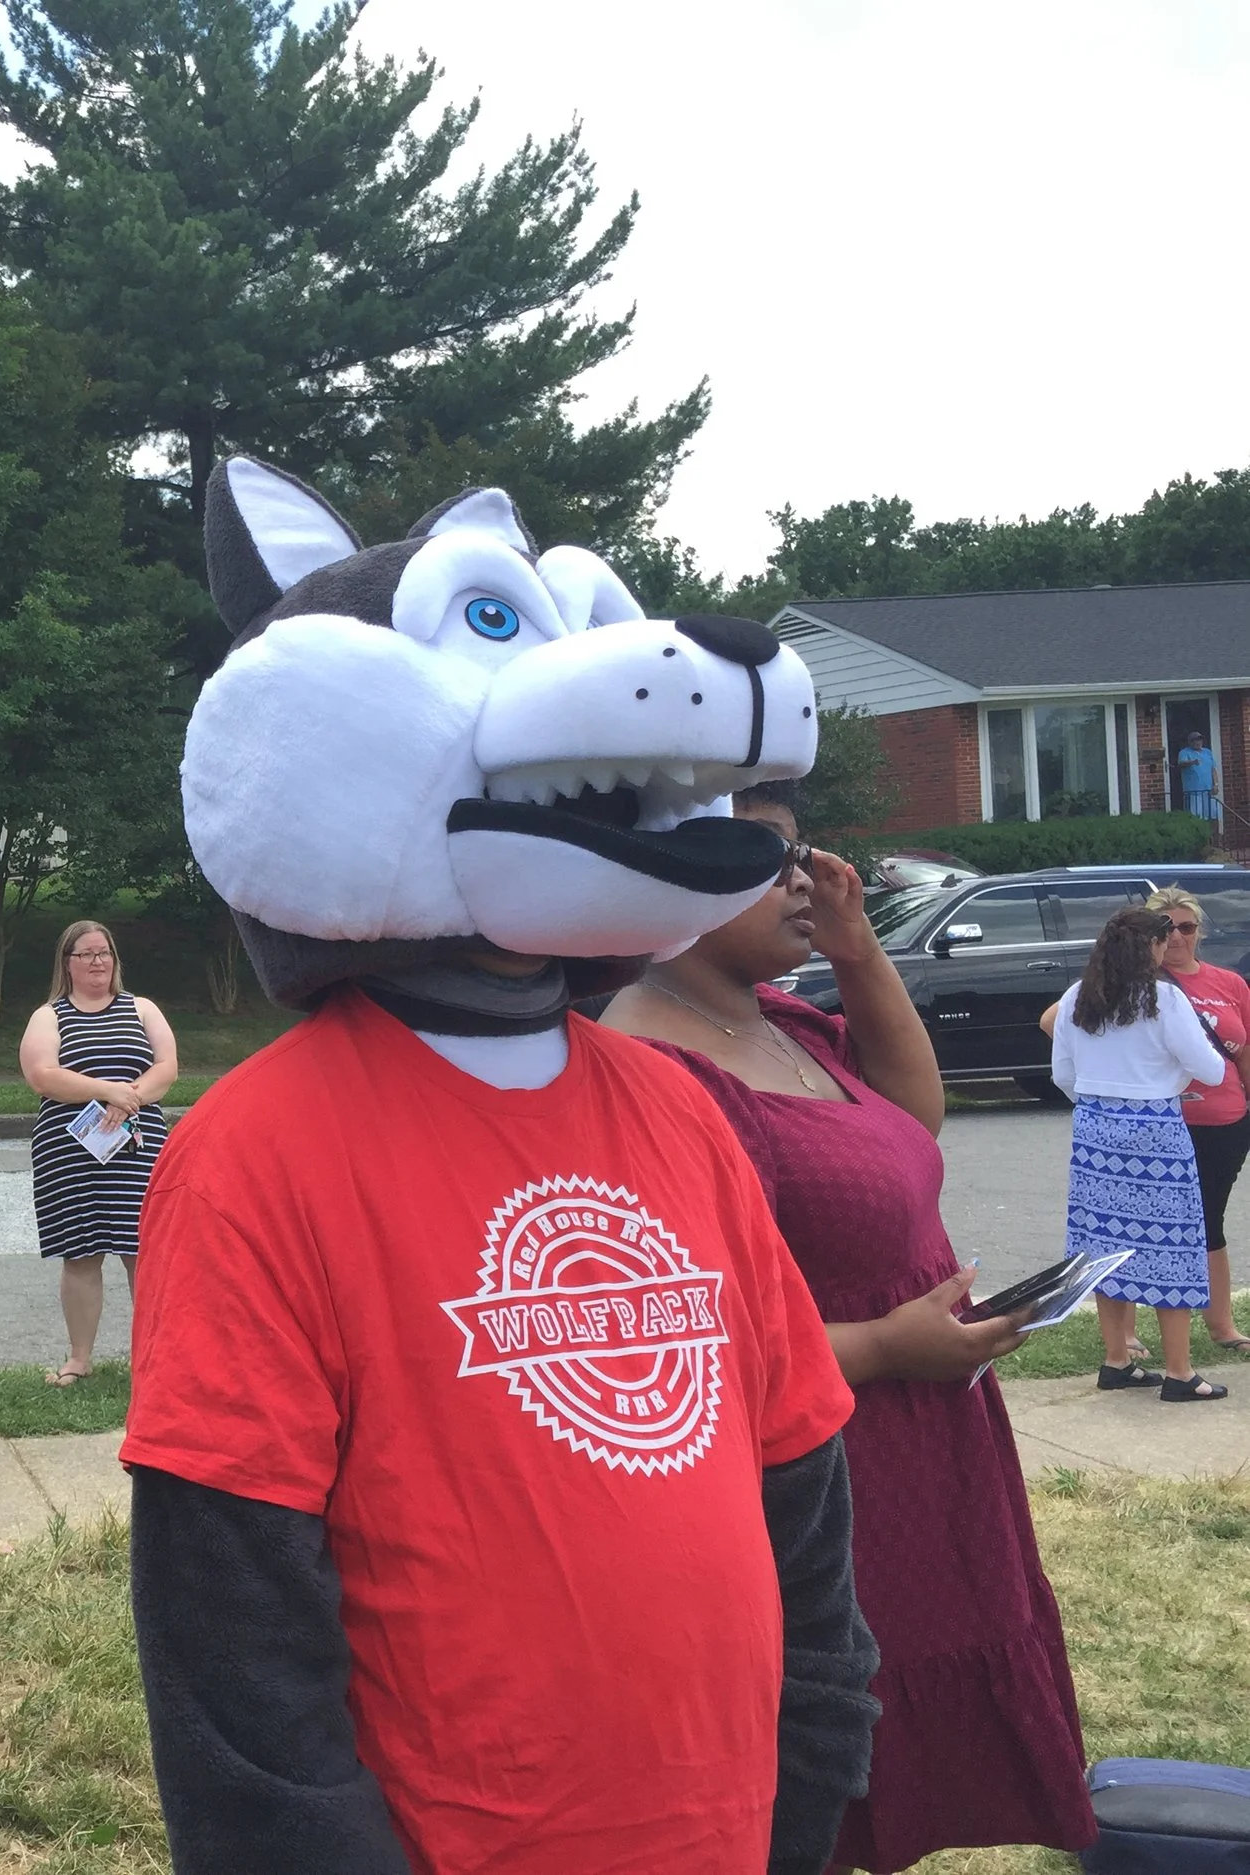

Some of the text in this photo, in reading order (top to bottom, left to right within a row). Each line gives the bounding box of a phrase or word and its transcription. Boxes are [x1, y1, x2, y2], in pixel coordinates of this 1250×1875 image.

[512, 1229, 540, 1281] Red
[536, 1211, 609, 1237] House
[478, 1286, 716, 1354] WOLFPACK
[614, 1389, 669, 1417] RHR
